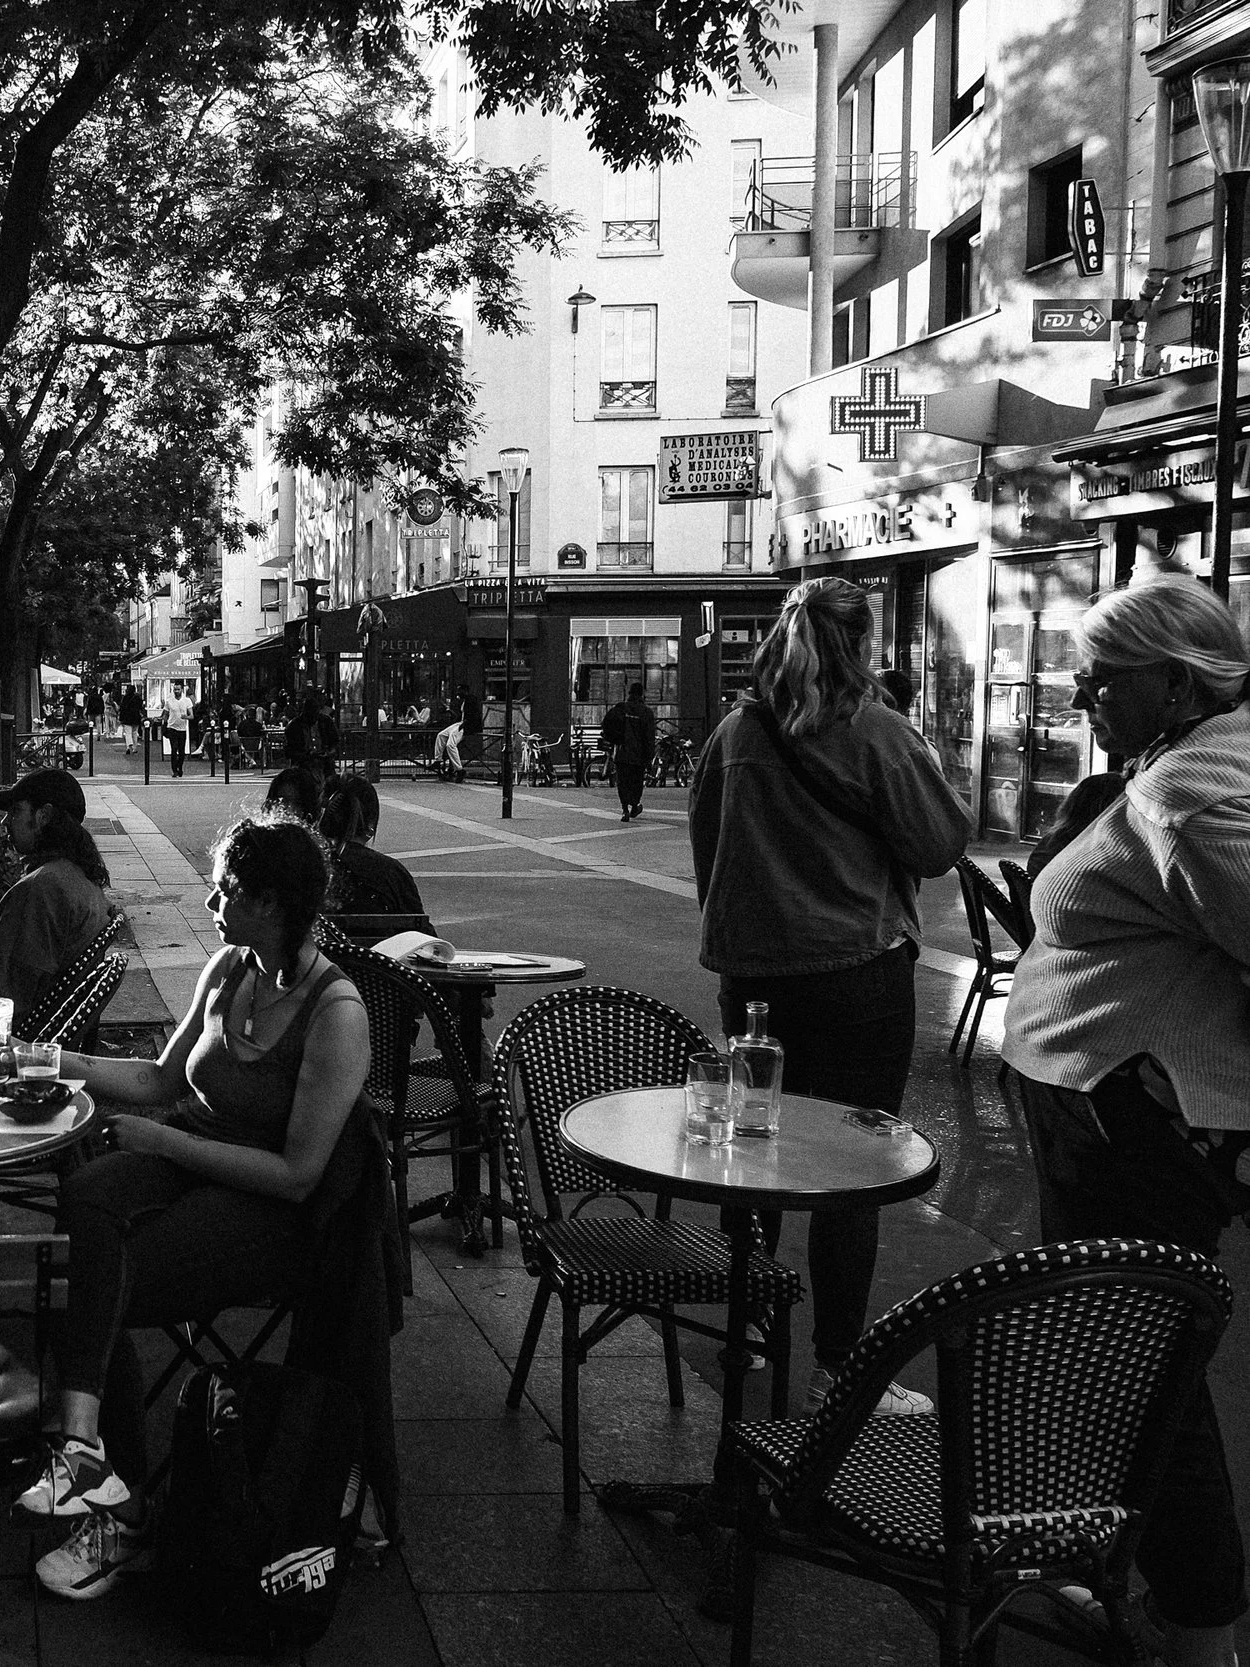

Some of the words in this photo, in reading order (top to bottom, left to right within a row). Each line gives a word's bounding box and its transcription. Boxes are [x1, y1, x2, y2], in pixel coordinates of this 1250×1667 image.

[1082, 185, 1098, 269] TABAC
[1042, 313, 1074, 327] FDJ
[663, 433, 754, 449] LABORATOIRE
[688, 446, 754, 460] D'ANALYSES
[688, 459, 747, 472] MEDICAL
[688, 470, 754, 484] COURONS
[713, 483, 730, 491] 03
[735, 482, 753, 490] 04
[1078, 475, 1120, 501] SNACKING
[402, 529, 449, 537] TRIPLETTA
[802, 504, 913, 555] PHARMACIE
[464, 578, 474, 588] LA
[478, 578, 500, 587] PIZZA
[526, 577, 546, 587] VITA
[473, 590, 544, 605] TRIPLTTA
[358, 639, 430, 651] TPLETTA
